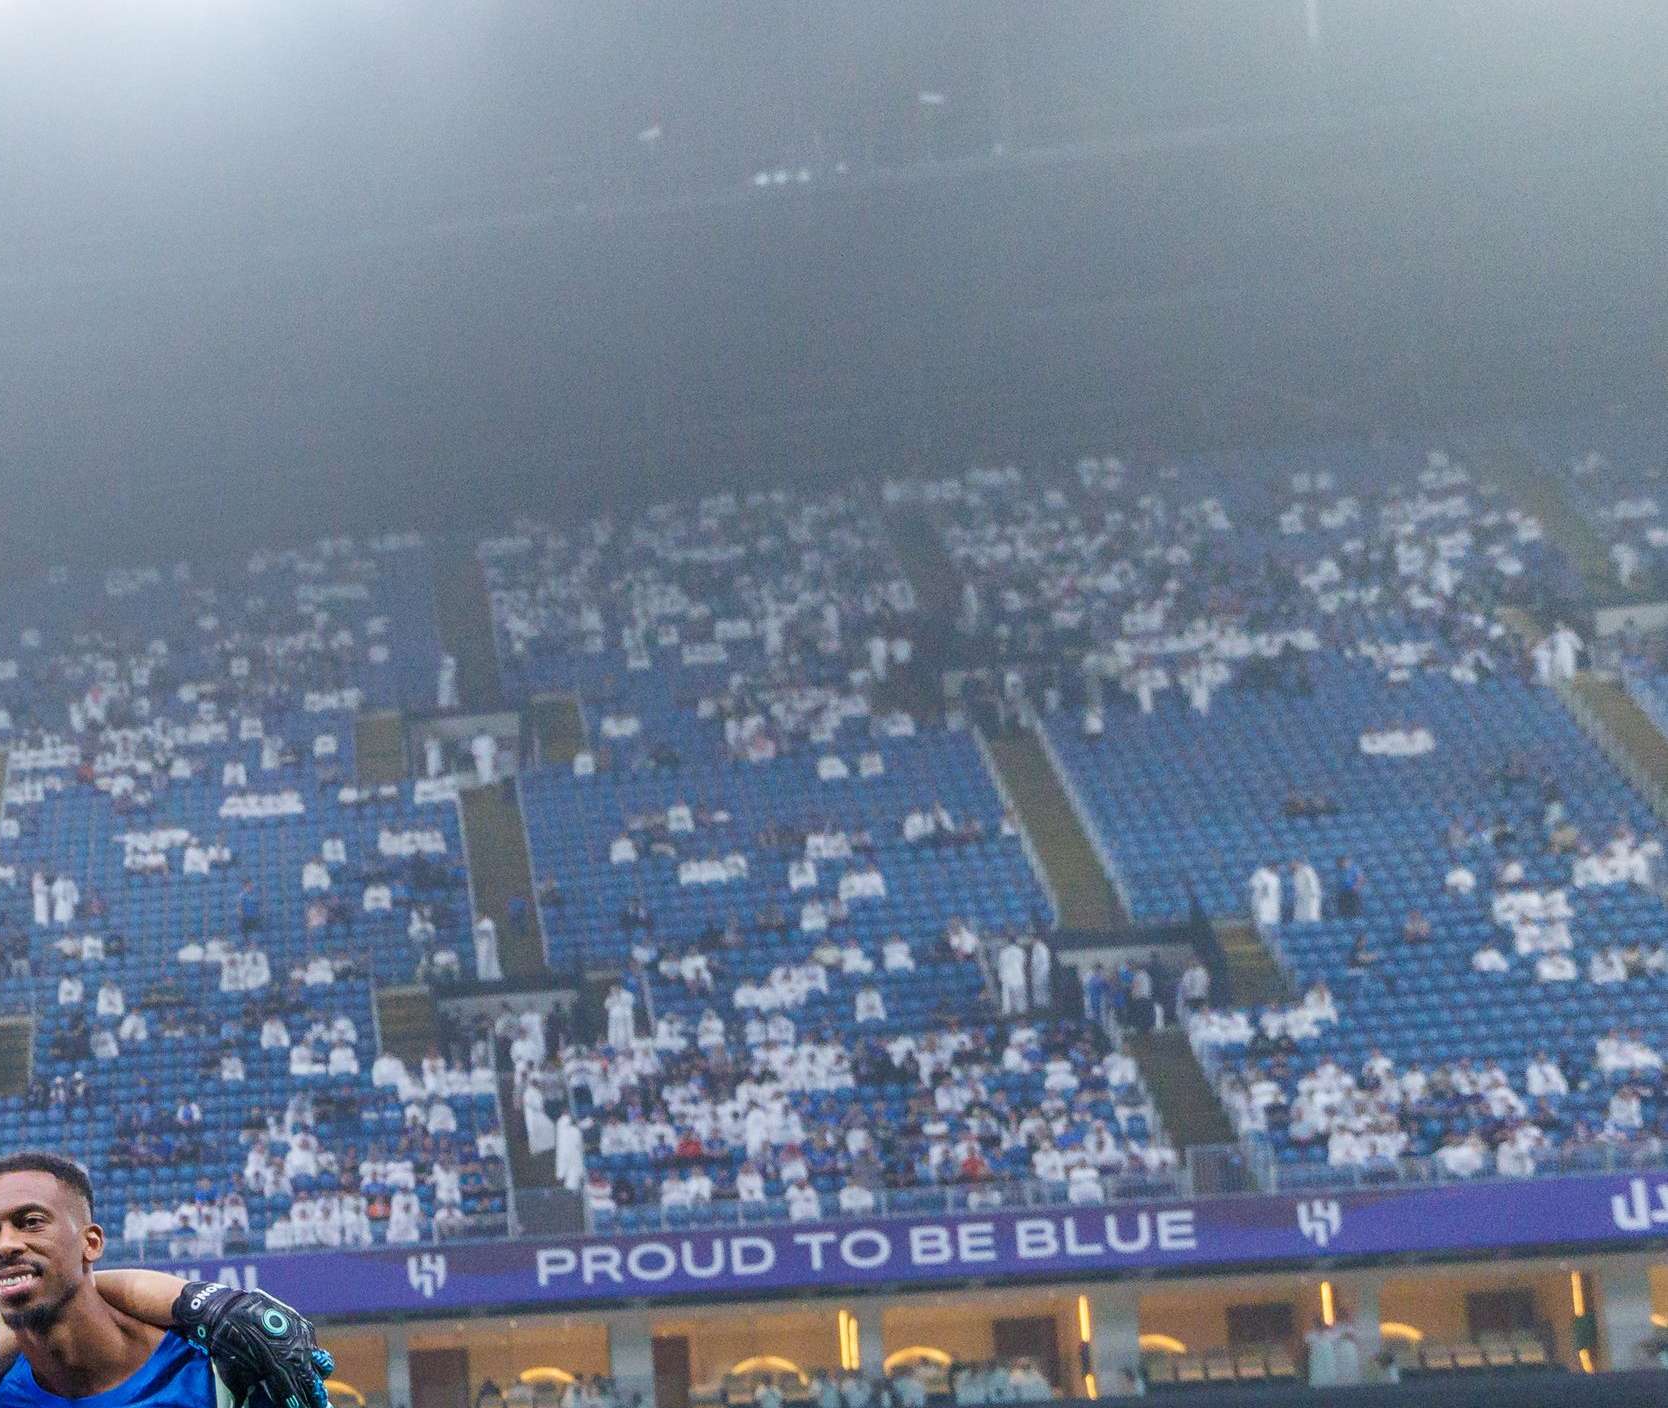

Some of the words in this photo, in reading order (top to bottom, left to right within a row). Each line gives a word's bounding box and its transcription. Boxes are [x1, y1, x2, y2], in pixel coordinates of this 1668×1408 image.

[536, 1236, 777, 1288] PROUD
[794, 1230, 891, 1270] TO
[910, 1223, 997, 1265] BE
[1016, 1210, 1196, 1260] BLUE
